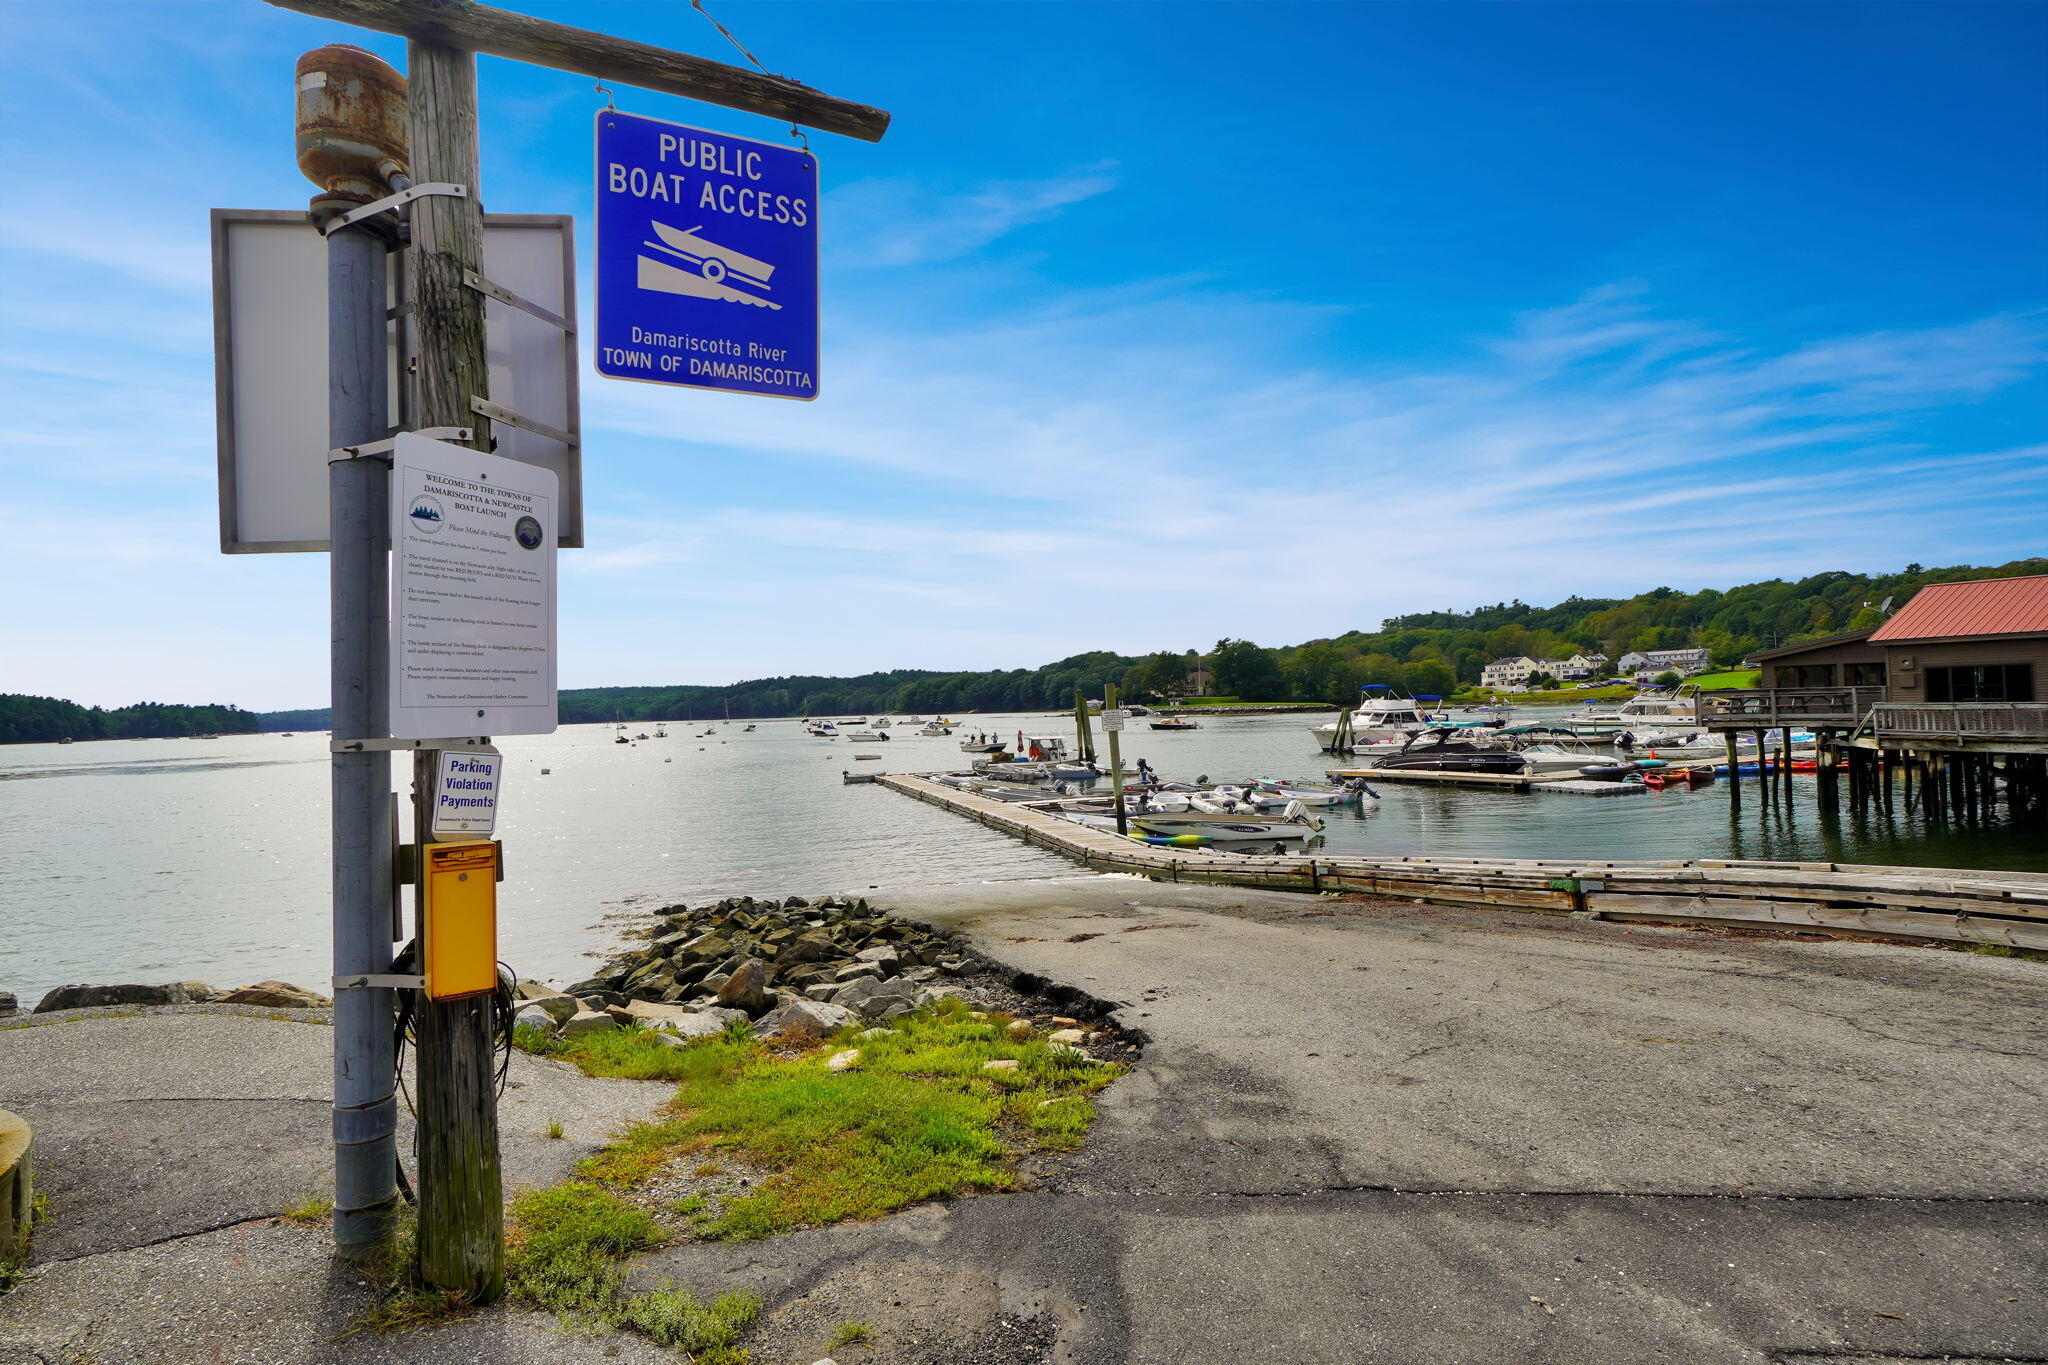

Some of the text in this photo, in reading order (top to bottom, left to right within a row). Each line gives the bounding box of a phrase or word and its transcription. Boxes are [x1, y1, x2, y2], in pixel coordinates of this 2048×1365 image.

[659, 133, 762, 181] PUBLIC
[609, 163, 808, 227] BOAT ACCESS
[631, 326, 787, 362] Damariscotta River
[603, 347, 812, 389] TOWN OF DAMARISCOTTA
[424, 485, 483, 504] DAMARISCOTTA
[491, 499, 533, 513] NEWCASTLE
[425, 474, 466, 489] WELCOME
[467, 483, 478, 491] TO
[479, 485, 496, 495] THE
[497, 489, 521, 501] TOWNS
[454, 502, 507, 518] BOAT LAUNCH
[450, 760, 492, 776] Parking
[446, 777, 493, 791] Violation
[440, 794, 494, 810] Payments
